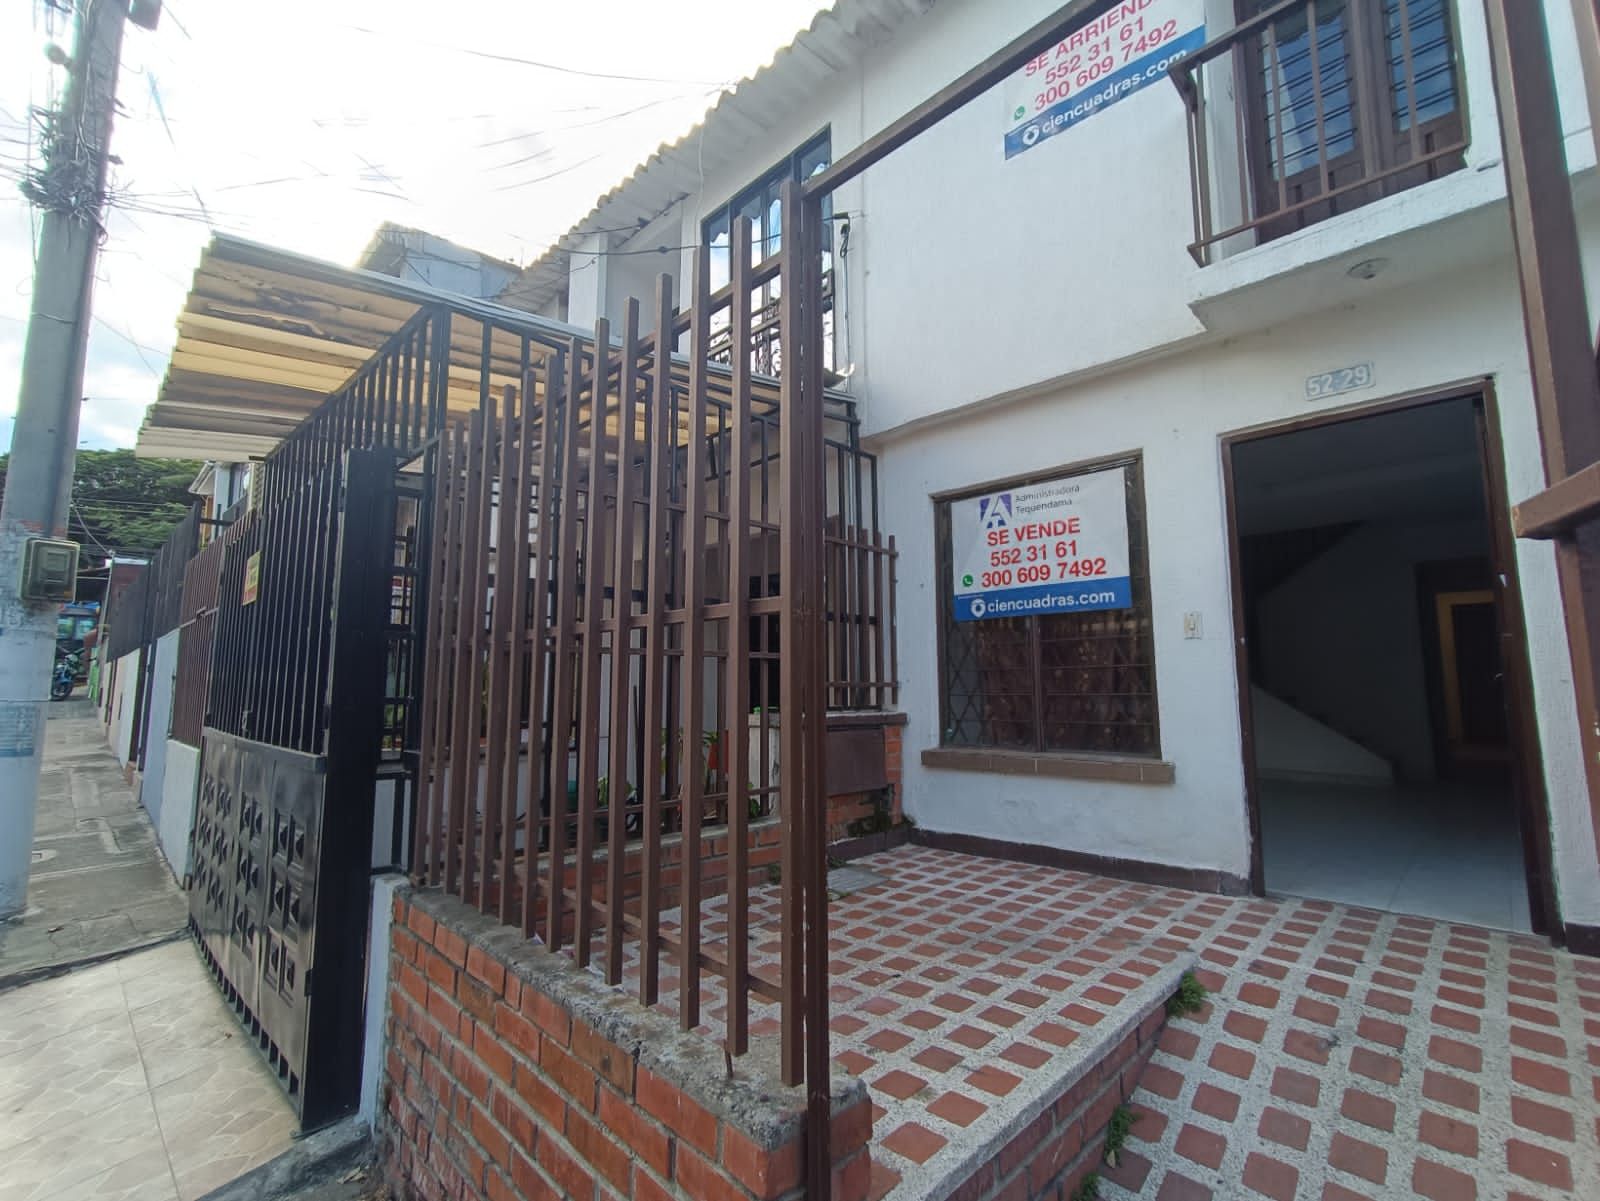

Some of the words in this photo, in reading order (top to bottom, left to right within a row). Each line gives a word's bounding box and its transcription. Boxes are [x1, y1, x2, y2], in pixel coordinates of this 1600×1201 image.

[1025, 54, 1049, 77] SE
[1056, 0, 1154, 59] ARRIEND
[1045, 54, 1081, 85] 552
[1088, 36, 1110, 61] 31
[1120, 16, 1143, 41] 61
[1034, 80, 1070, 111] 300
[1076, 55, 1113, 87] 609
[1120, 19, 1177, 62] 7492
[1042, 50, 1187, 133] ciencuadras.com
[1015, 484, 1080, 502] Administradora
[1015, 498, 1073, 514] Tequendama
[987, 529, 1010, 547] SE
[1014, 517, 1080, 542] VENDE
[990, 548, 1021, 567] 552
[1026, 544, 1047, 562] 31
[1055, 540, 1077, 558] 61
[981, 569, 1012, 588] 300
[1017, 564, 1050, 583] 609
[1057, 558, 1107, 579] 7492
[987, 590, 1115, 613] ciencuadras.com
